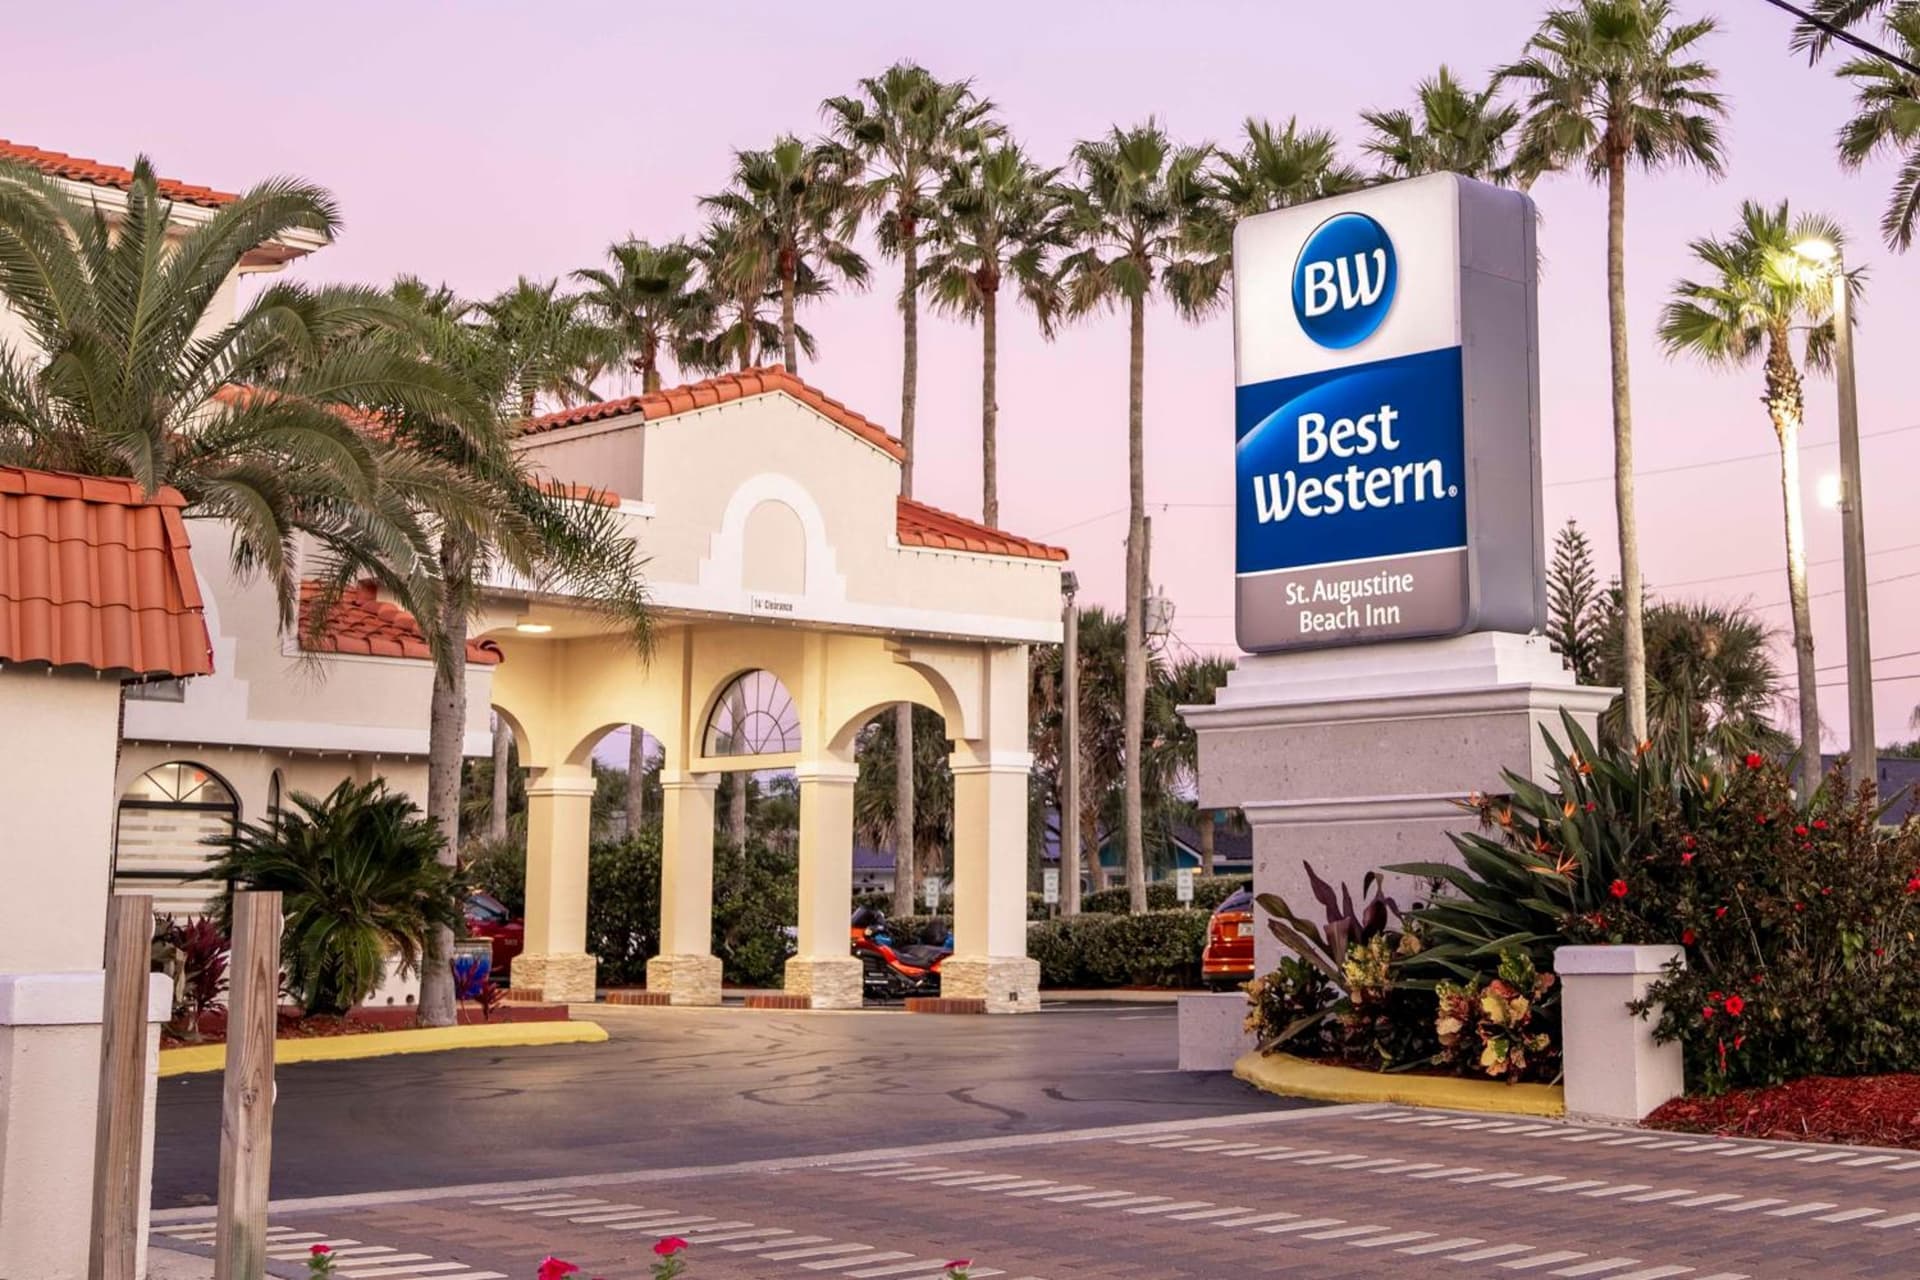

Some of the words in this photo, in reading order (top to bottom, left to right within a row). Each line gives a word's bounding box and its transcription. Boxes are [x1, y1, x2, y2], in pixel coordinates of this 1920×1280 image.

[1304, 248, 1386, 317] BW
[1298, 405, 1400, 463] Best
[1285, 582, 1310, 605] St.
[1311, 570, 1414, 605] Augustine
[764, 599, 793, 612] Clearance
[1300, 605, 1360, 633] Beach
[1366, 604, 1401, 626] Inn
